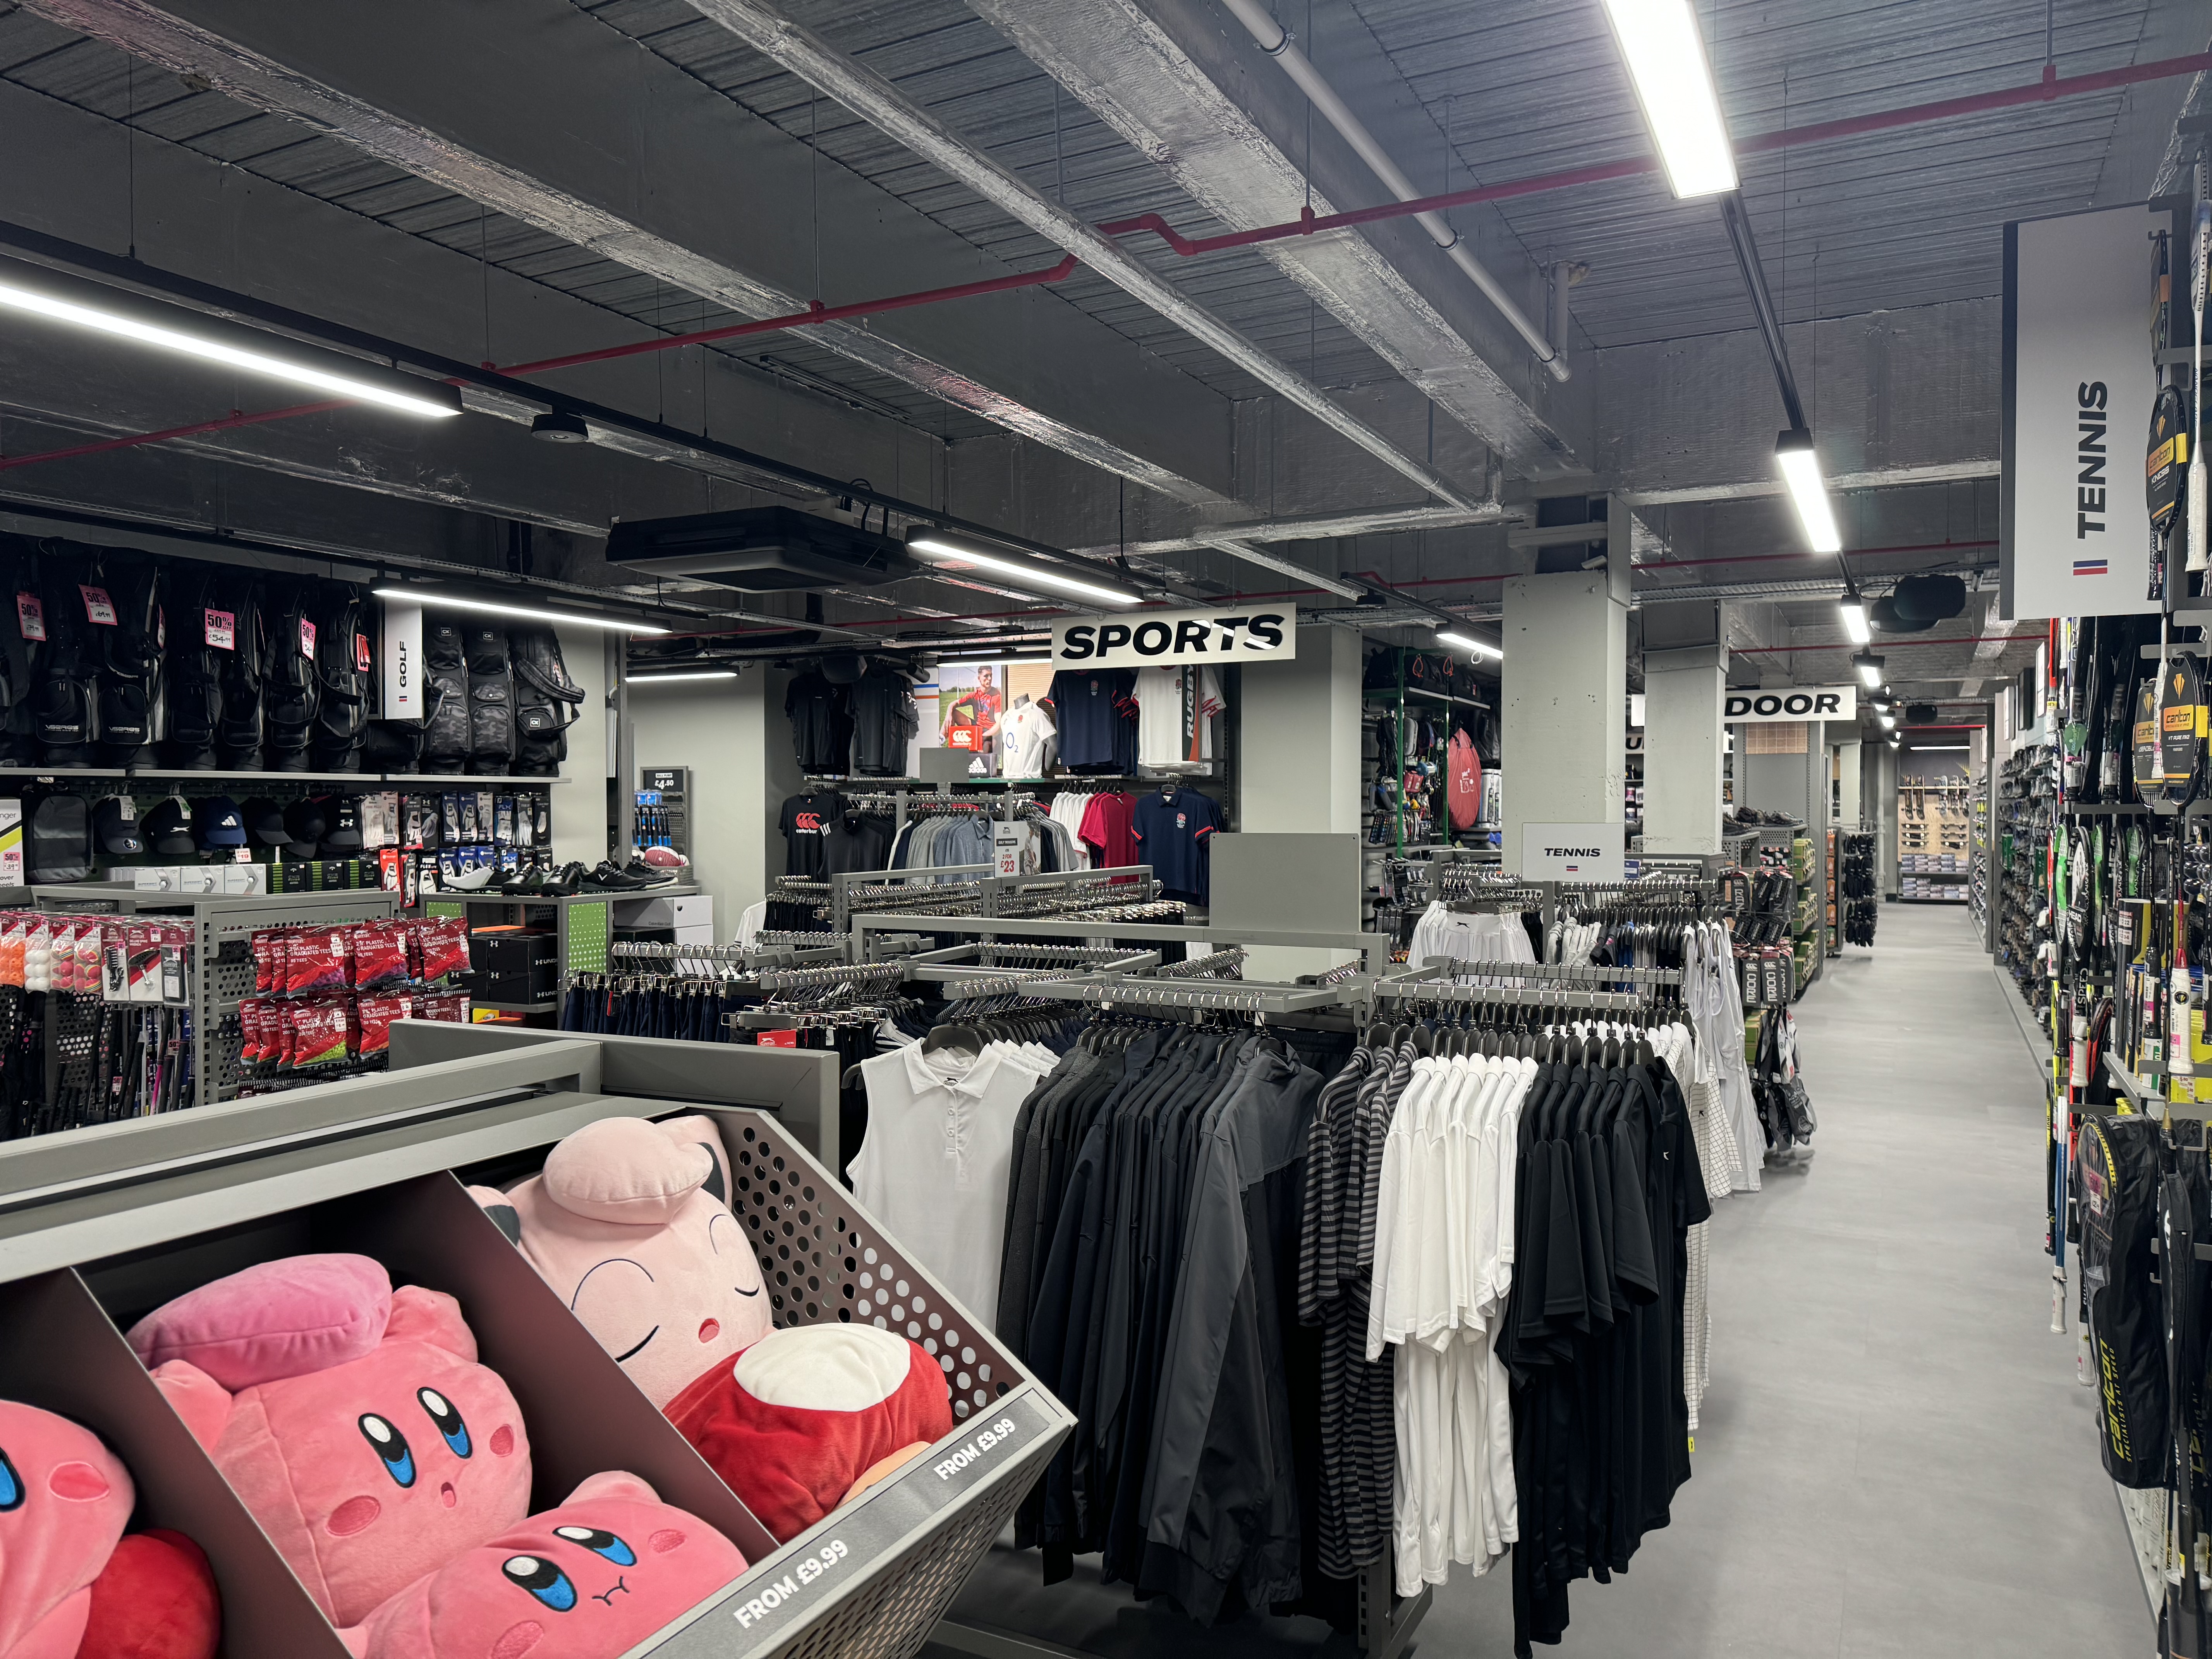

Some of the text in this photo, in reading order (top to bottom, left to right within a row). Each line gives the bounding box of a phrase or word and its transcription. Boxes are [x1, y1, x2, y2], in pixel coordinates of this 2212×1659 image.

[2078, 381, 2108, 539] TENNIS
[208, 614, 232, 628] 50%
[1060, 614, 1285, 660] SPORTS
[2166, 709, 2190, 723] carlton
[655, 780, 674, 790] £4.50
[1000, 860, 1015, 872] £23
[1544, 848, 1601, 857] TENNIS
[2069, 910, 2082, 923] HEAD
[1747, 973, 1757, 1003] CORE
[1766, 972, 1778, 1002] CORE
[2077, 967, 2088, 1005] SPEED
[2100, 1338, 2124, 1459] carlton
[2109, 1348, 2133, 1463] SPECIALISTS AT SPEED
[933, 1418, 1015, 1481] FROM £9.99
[733, 1539, 848, 1628] FROM £9.99
